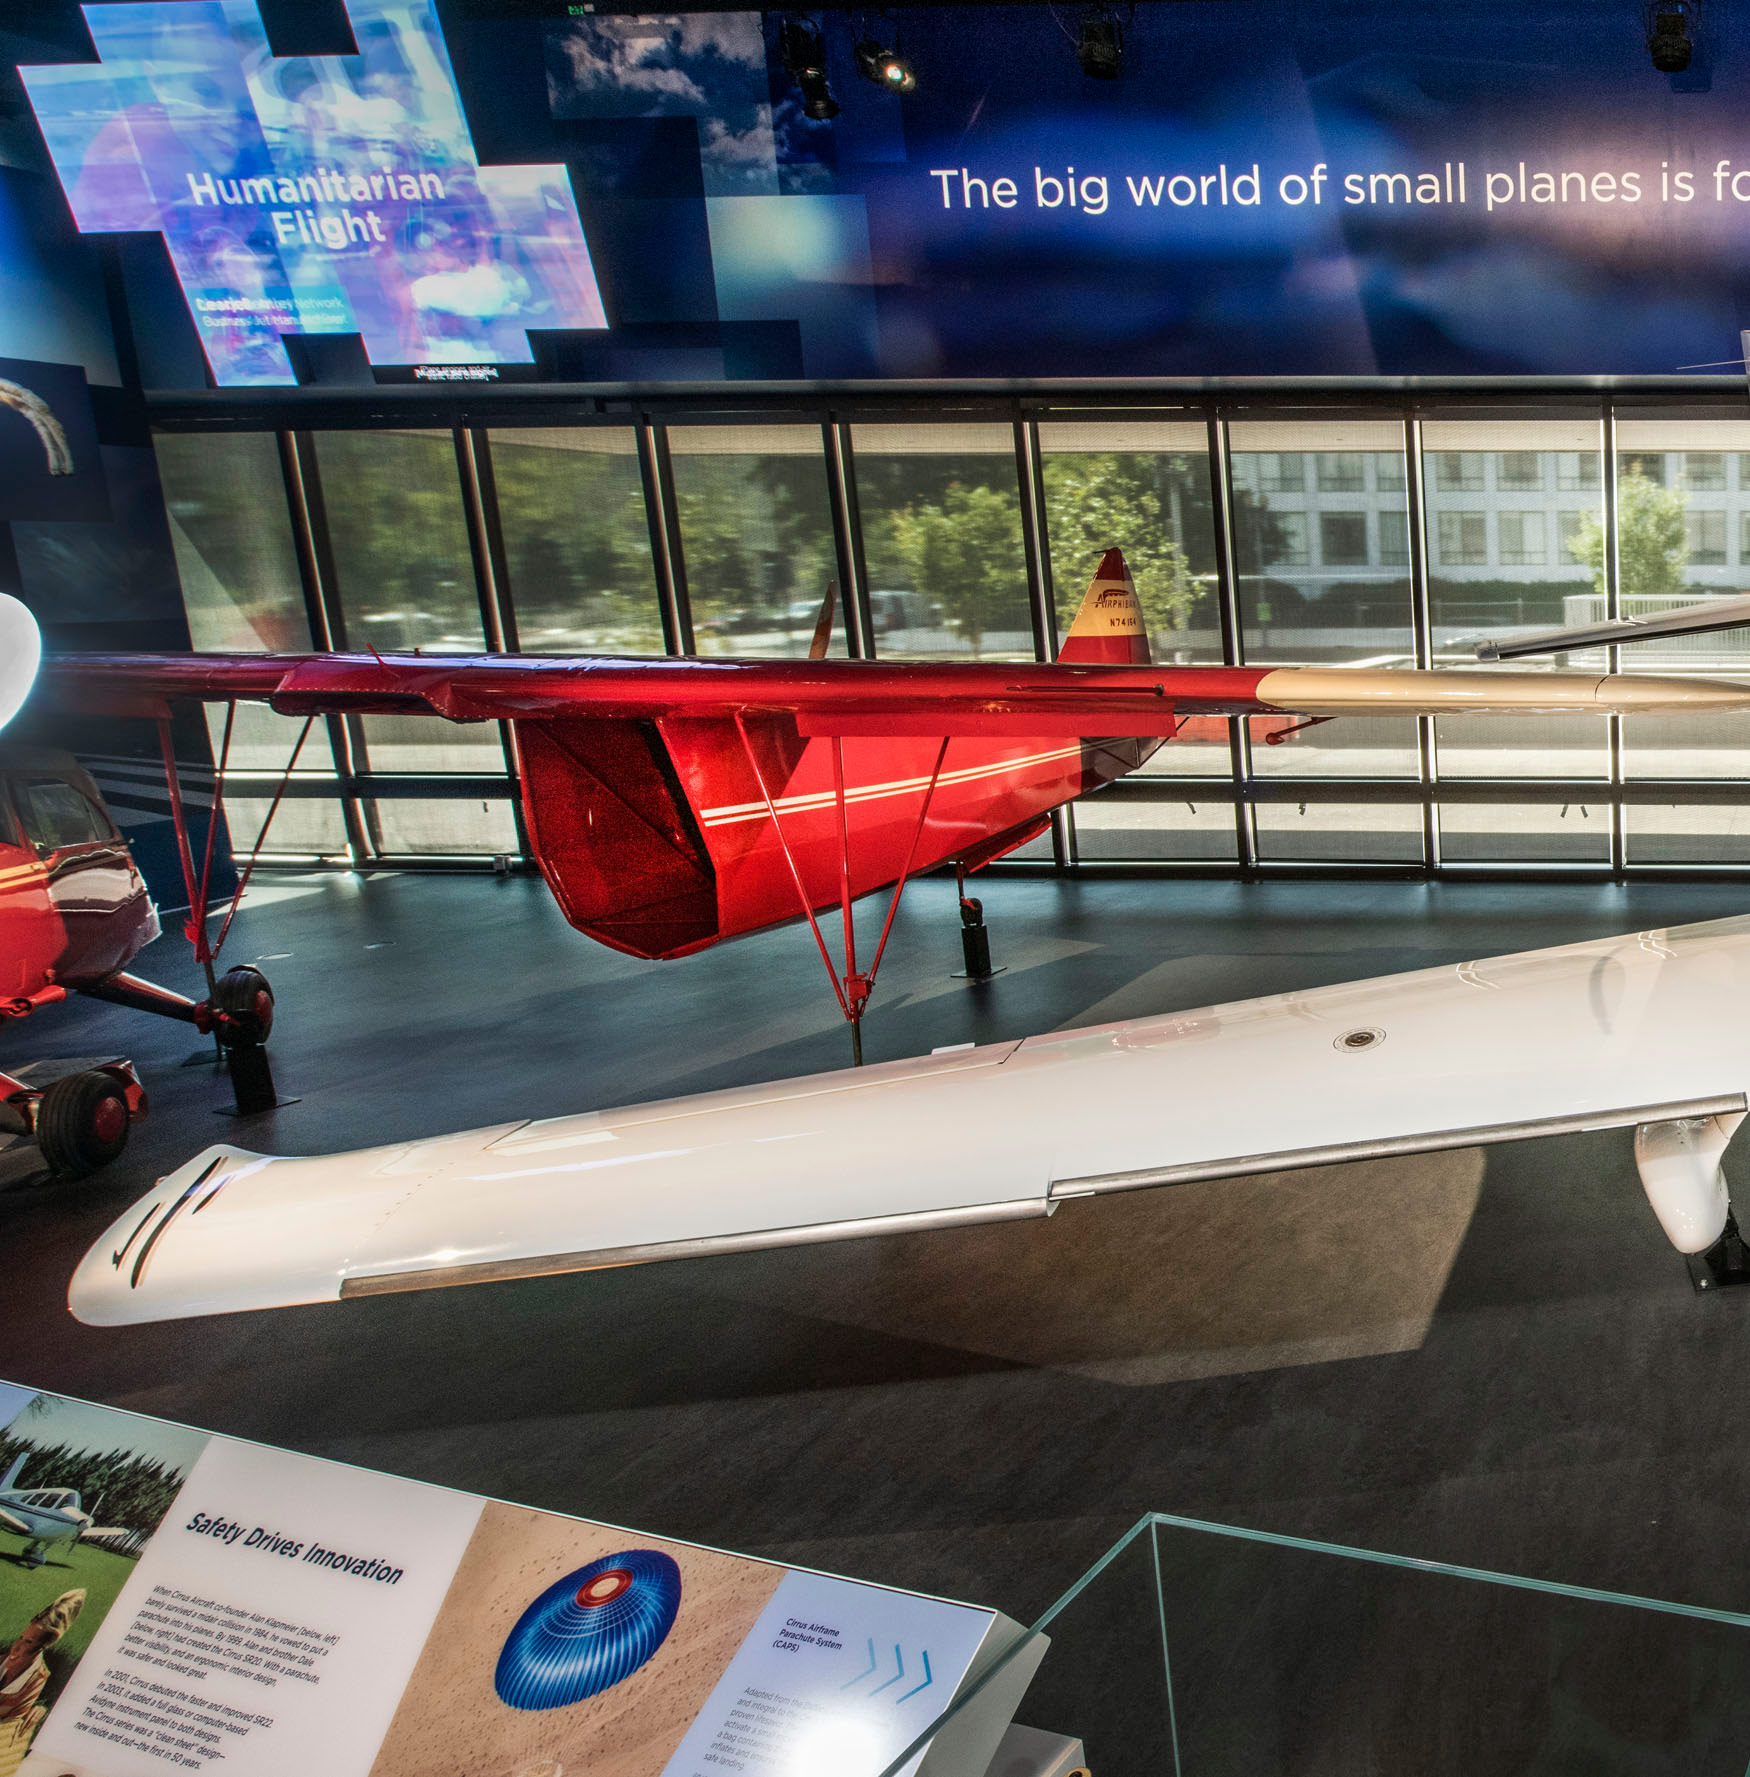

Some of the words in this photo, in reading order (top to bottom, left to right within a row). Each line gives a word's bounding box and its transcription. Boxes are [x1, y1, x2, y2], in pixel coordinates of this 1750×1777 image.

[186, 166, 446, 206] Humanitarian
[930, 168, 1018, 209] The
[1035, 166, 1109, 215] big
[1126, 164, 1261, 207] world
[1278, 163, 1328, 206] of
[1344, 162, 1466, 205] small
[1485, 161, 1643, 211] planes
[1661, 161, 1695, 203] is
[270, 208, 387, 250] Flight
[186, 1512, 247, 1545] Safety
[243, 1527, 304, 1558] Drives
[302, 1542, 404, 1585] Innovation
[145, 1597, 166, 1609] barely
[165, 1604, 194, 1616] survived
[197, 1613, 219, 1623] midair
[217, 1619, 245, 1631] collision
[269, 1633, 279, 1642] he
[279, 1638, 304, 1648] vowed
[301, 1642, 310, 1650] to
[308, 1646, 323, 1654] put
[153, 1585, 172, 1596] When
[171, 1590, 190, 1601] Cirrus
[190, 1596, 215, 1608] Aircraft
[213, 1604, 250, 1618] co-founder
[248, 1613, 265, 1623] Alan
[264, 1617, 299, 1632] Klapmeier
[323, 1633, 340, 1645] left]
[786, 1617, 808, 1630] Cirrus
[807, 1623, 840, 1637] Airframe
[124, 1633, 146, 1644] better
[171, 1649, 187, 1657] and
[193, 1656, 229, 1671] ergonomic
[228, 1665, 254, 1678] interior
[136, 1610, 170, 1624] parachute
[169, 1618, 183, 1627] into
[182, 1622, 193, 1631] his
[215, 1631, 226, 1641] By
[242, 1640, 259, 1650] Alan
[258, 1646, 274, 1654] and
[271, 1648, 299, 1661] brother
[297, 1655, 314, 1667] Dale
[154, 1629, 175, 1640] right]
[173, 1634, 188, 1643] had
[186, 1638, 213, 1650] created
[210, 1645, 223, 1654] the
[222, 1648, 243, 1660] Cirrus
[263, 1660, 280, 1671] With
[772, 1639, 800, 1653] (CAPS)
[779, 1628, 815, 1644] Parachute
[815, 1637, 843, 1650] System
[123, 1649, 137, 1657] was
[135, 1653, 154, 1662] safer
[151, 1658, 168, 1666] and
[165, 1660, 190, 1673] looked
[96, 1681, 105, 1689] In
[103, 1683, 124, 1696] 2003,
[123, 1690, 131, 1698] it
[128, 1693, 153, 1704] added
[155, 1699, 169, 1710] full
[165, 1704, 185, 1715] glass
[184, 1710, 194, 1718] or
[193, 1713, 250, 1736] computer-based
[104, 1668, 112, 1676] In
[129, 1676, 149, 1688] Cirrus
[148, 1683, 178, 1697] debuted
[176, 1691, 188, 1701] the
[187, 1694, 208, 1707] faster
[206, 1702, 223, 1711] and
[220, 1705, 256, 1721] improved
[252, 1715, 273, 1728] SR22.
[736, 1697, 751, 1707] and
[744, 1686, 774, 1701] Adapted
[82, 1706, 96, 1717] The
[95, 1711, 115, 1724] Cirrus
[113, 1719, 135, 1730] series
[133, 1726, 148, 1735] was
[88, 1694, 116, 1709] Avidyne
[115, 1703, 152, 1720] instrument
[148, 1715, 171, 1726] panel
[168, 1720, 178, 1729] to
[177, 1722, 194, 1734] both
[193, 1728, 221, 1743] designs.
[724, 1719, 751, 1734] activate
[729, 1708, 755, 1721] proven
[74, 1721, 89, 1731] new
[88, 1727, 109, 1738] inside
[107, 1733, 124, 1742] and
[149, 1745, 165, 1757] first
[162, 1750, 172, 1759] in
[170, 1752, 183, 1762] 50
[179, 1758, 201, 1769] years.
[704, 1751, 719, 1763] safe
[710, 1741, 736, 1755] inflates
[723, 1731, 738, 1744] bag
